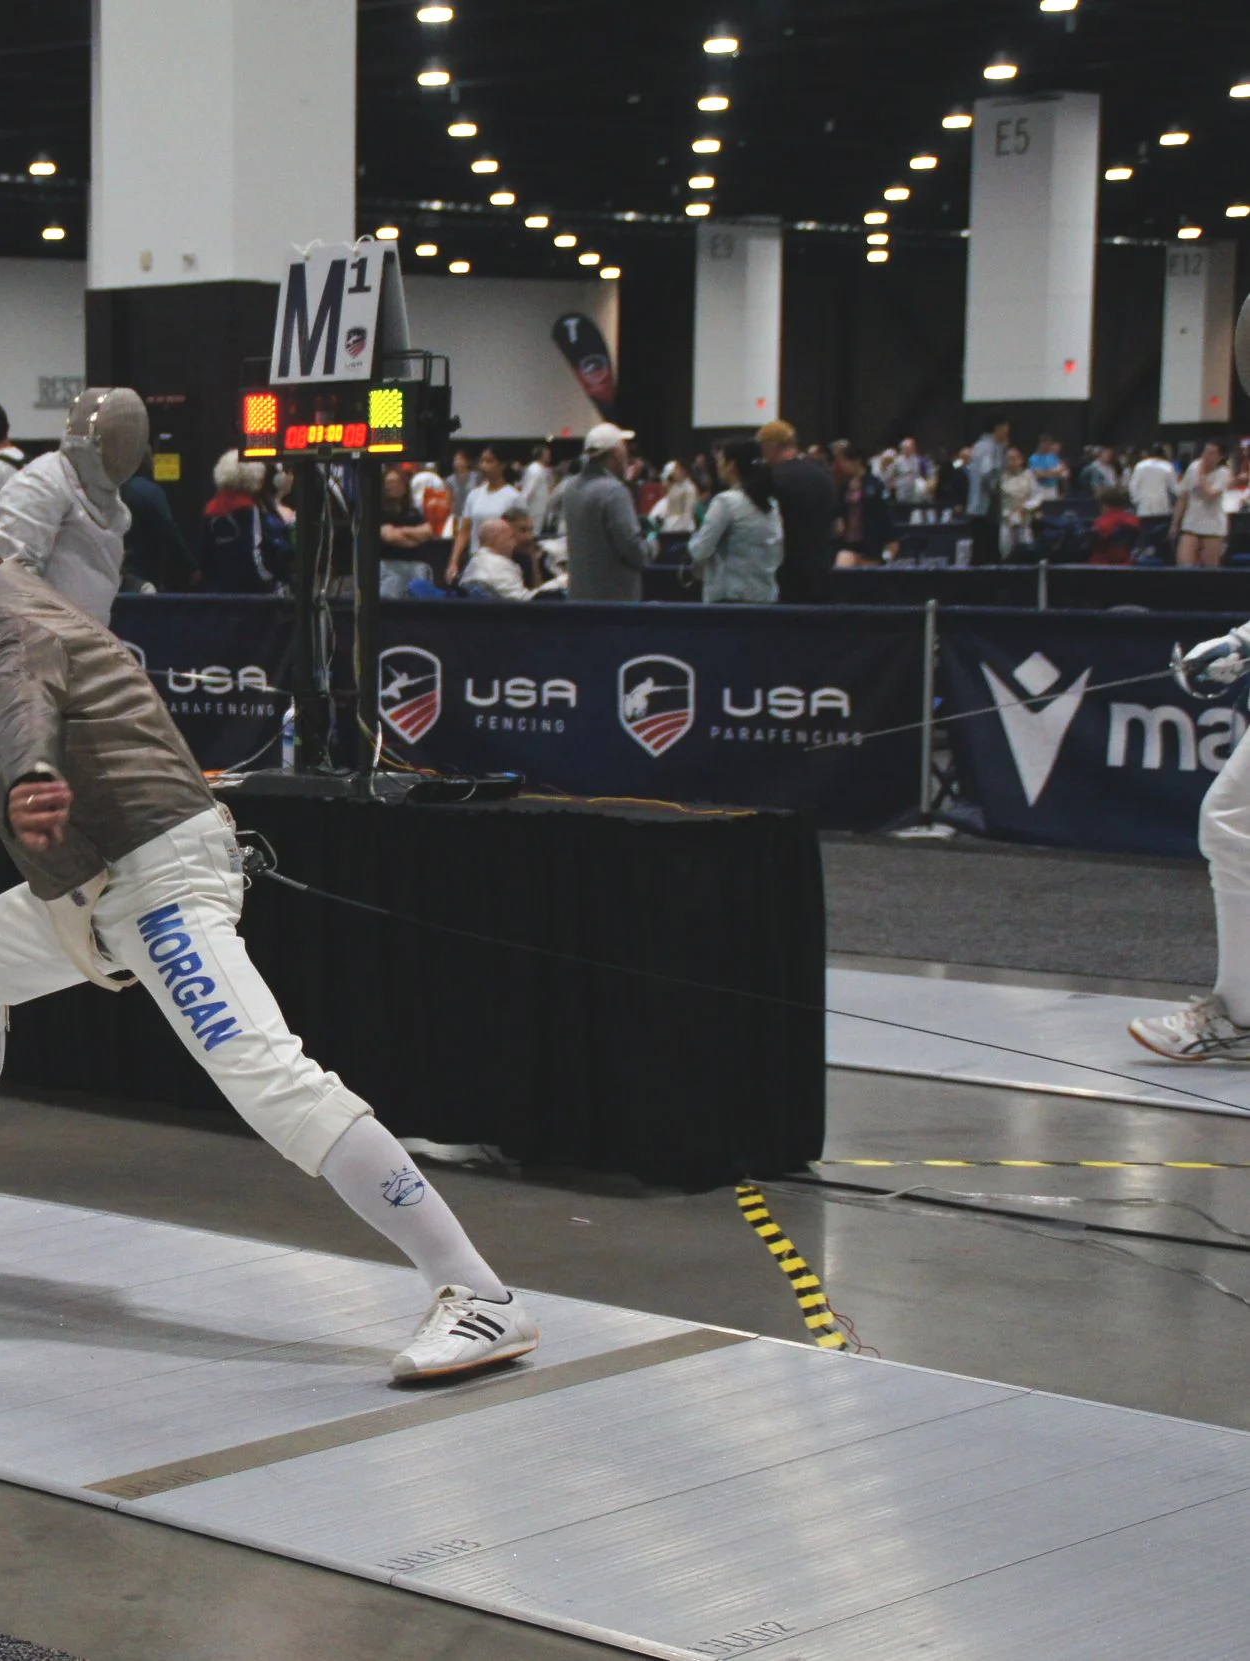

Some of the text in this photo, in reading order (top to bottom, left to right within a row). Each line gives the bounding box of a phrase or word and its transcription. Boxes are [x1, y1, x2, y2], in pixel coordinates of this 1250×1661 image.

[996, 118, 1030, 156] E5
[563, 317, 579, 344] T
[307, 424, 343, 443] 03:00
[168, 665, 267, 694] USA
[465, 677, 576, 708] USA
[166, 702, 274, 716] ARAFENCING
[723, 685, 850, 718] USA
[475, 714, 565, 733] FENCING
[710, 726, 864, 746] PARAFENCING
[137, 903, 242, 1051] MORGAN
